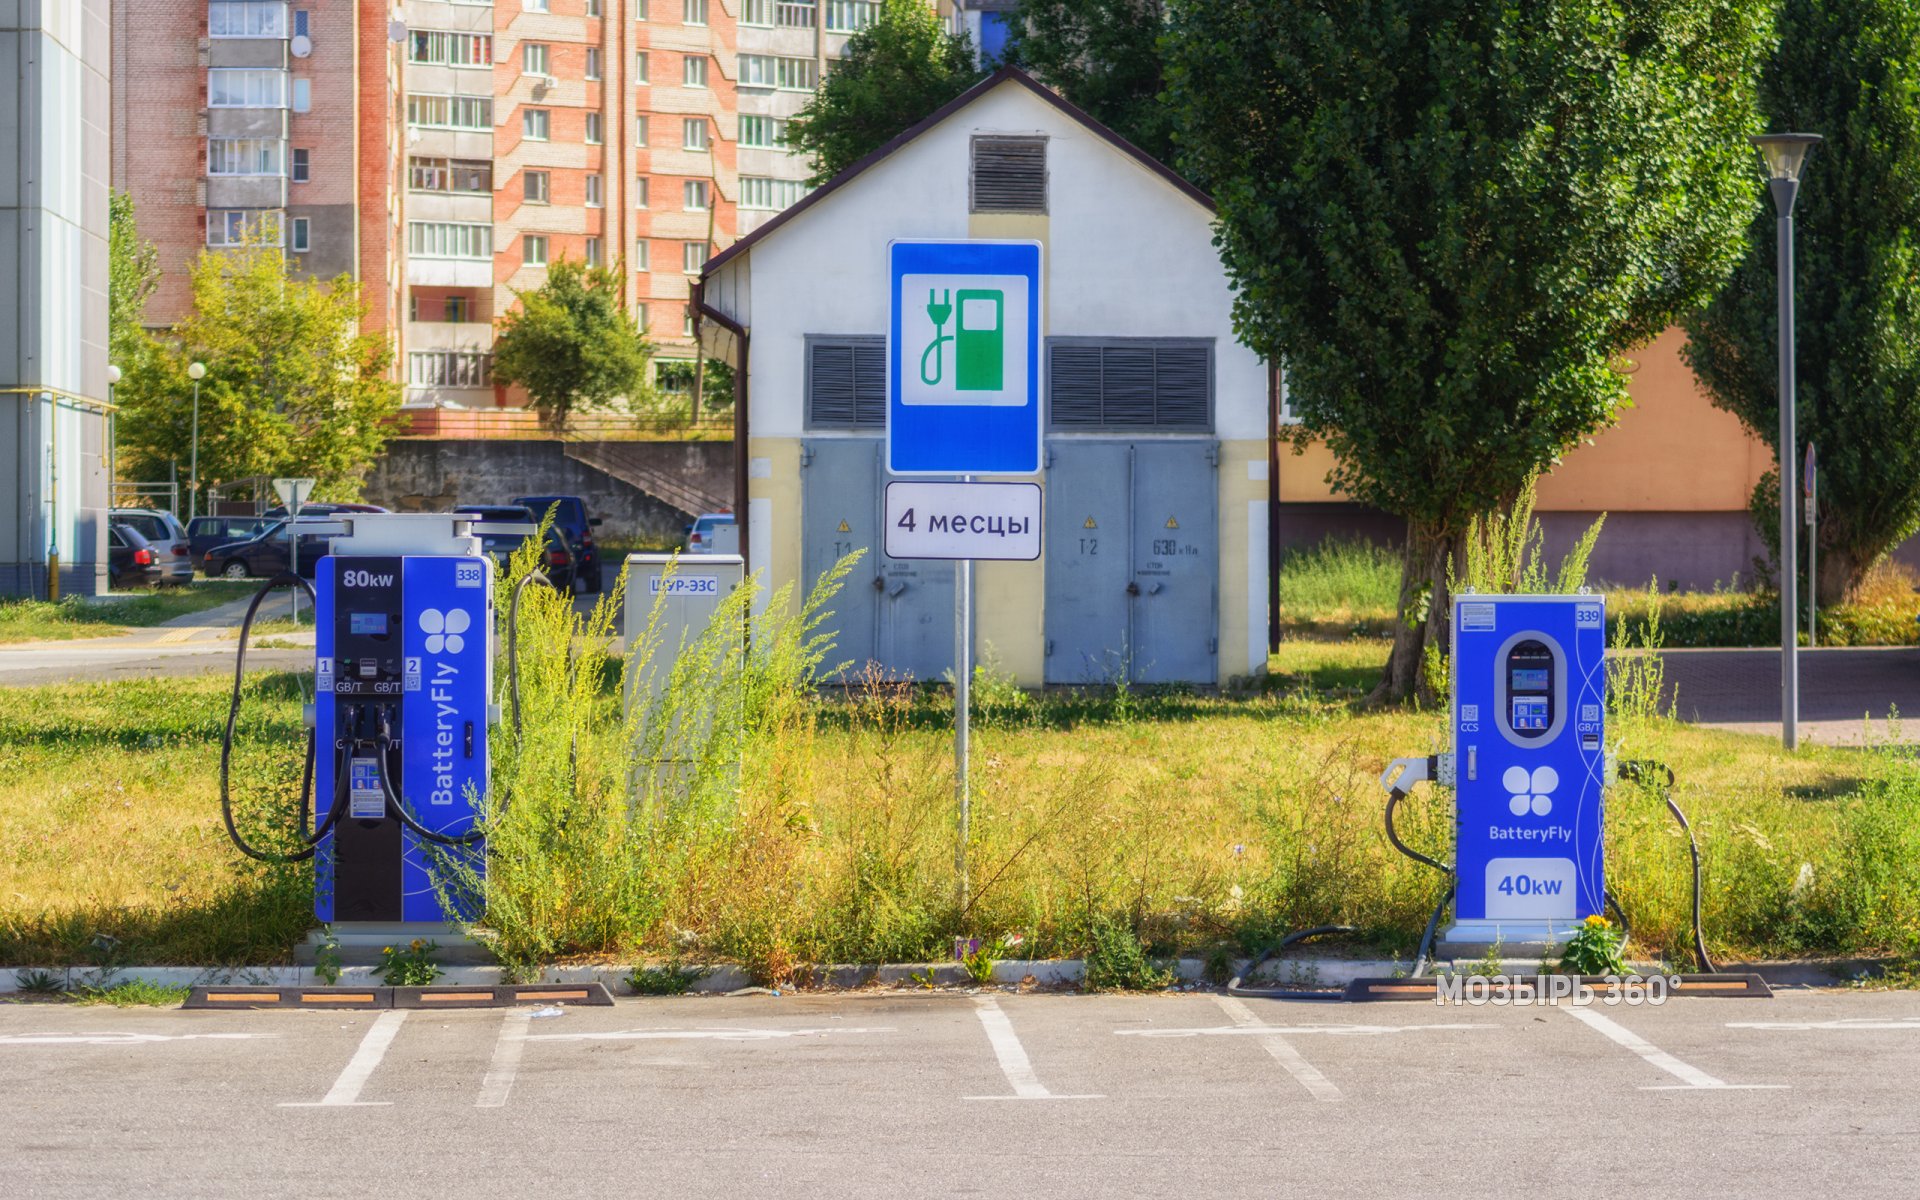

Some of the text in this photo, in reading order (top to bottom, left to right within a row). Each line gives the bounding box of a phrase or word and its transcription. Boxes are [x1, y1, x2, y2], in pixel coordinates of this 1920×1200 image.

[897, 508, 1029, 537] 4 месцы
[1153, 539, 1176, 556] 630
[343, 570, 394, 587] 80kW
[457, 569, 480, 580] 338
[1577, 610, 1599, 622] 339
[321, 660, 329, 672] 1
[408, 660, 417, 672] 2
[336, 682, 401, 694] GB/T GB/T
[1460, 723, 1479, 732] CCS
[1577, 723, 1601, 733] GB/T
[430, 662, 459, 806] BatteryFly
[335, 738, 364, 750] GT
[1489, 826, 1572, 843] BatteryFly
[1497, 875, 1563, 896] 40kW
